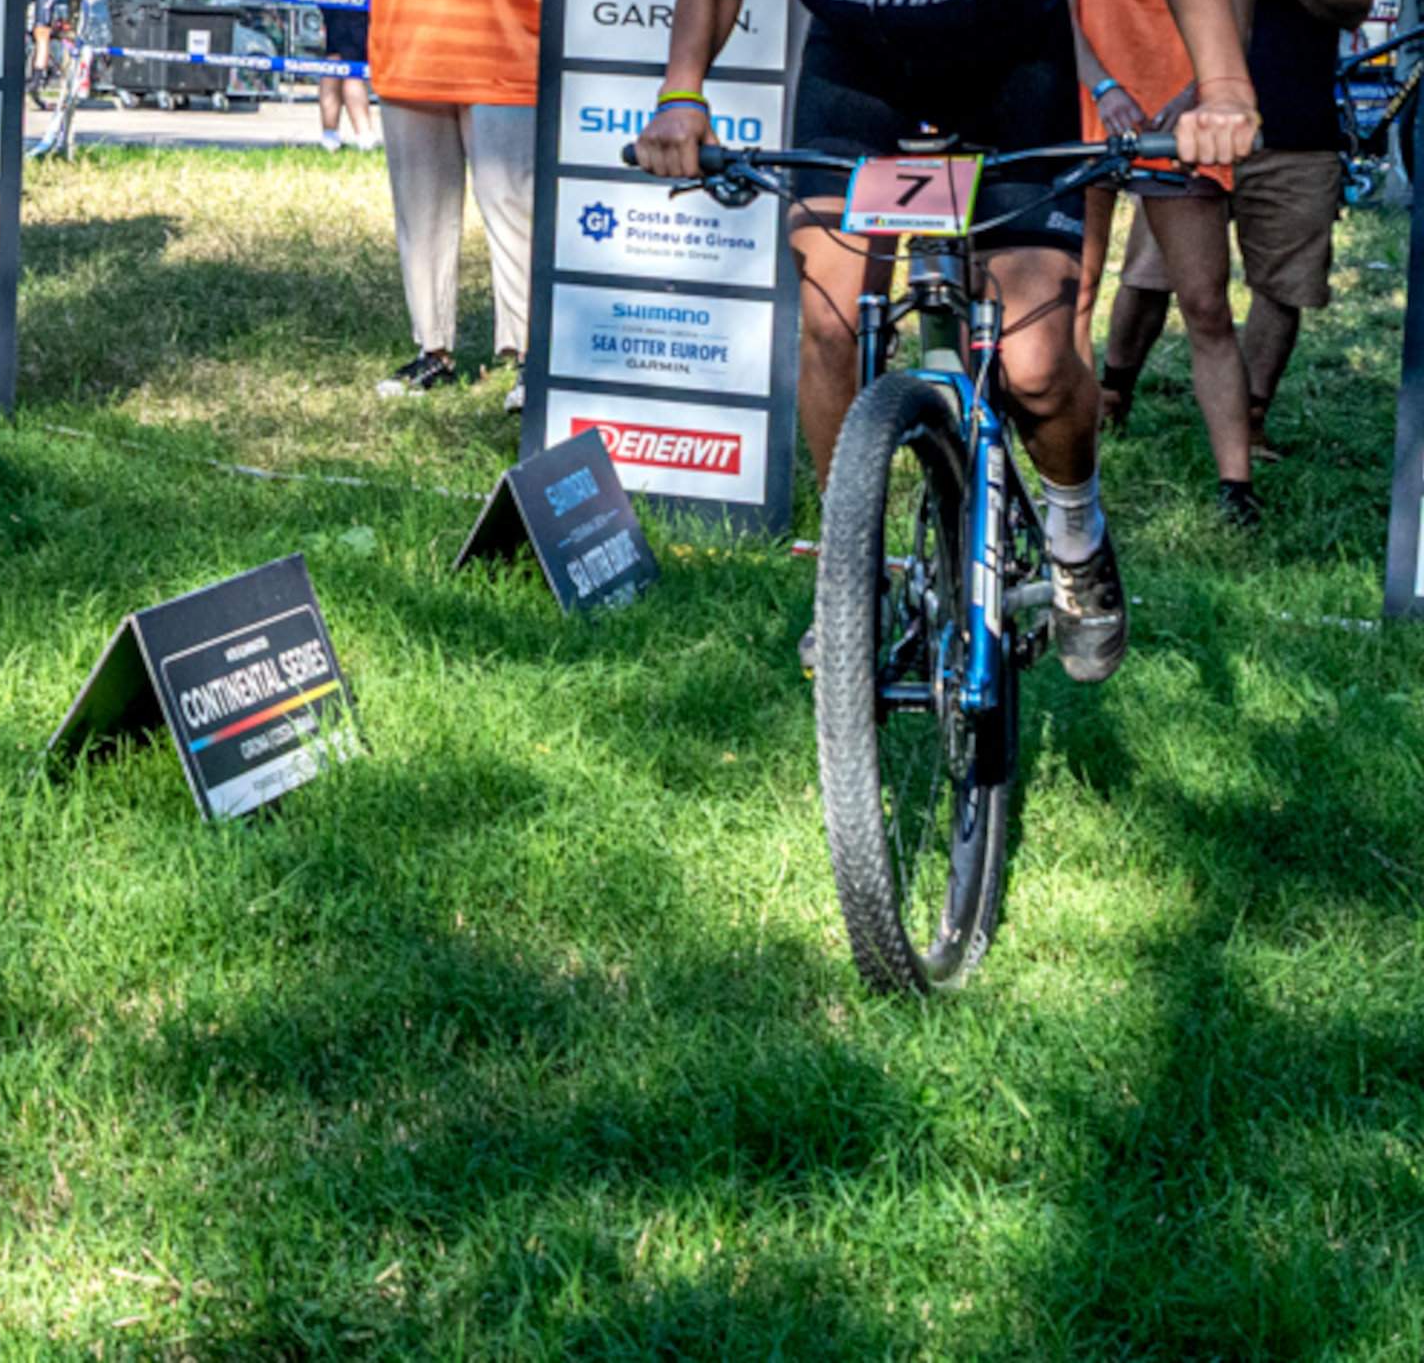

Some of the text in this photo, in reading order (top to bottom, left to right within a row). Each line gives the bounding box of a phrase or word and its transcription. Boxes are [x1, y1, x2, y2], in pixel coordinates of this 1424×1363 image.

[896, 174, 934, 207] 7
[627, 209, 720, 229] Costa Brava
[626, 227, 756, 251] Pirineu de Girona
[612, 302, 710, 326] SHIMANO
[592, 334, 729, 364] SEA OTTER EUROPE
[626, 357, 691, 376] GARMIN
[616, 433, 739, 469] ENERVIT
[180, 658, 289, 729] CONTINENTAL
[278, 638, 330, 687] SERIES
